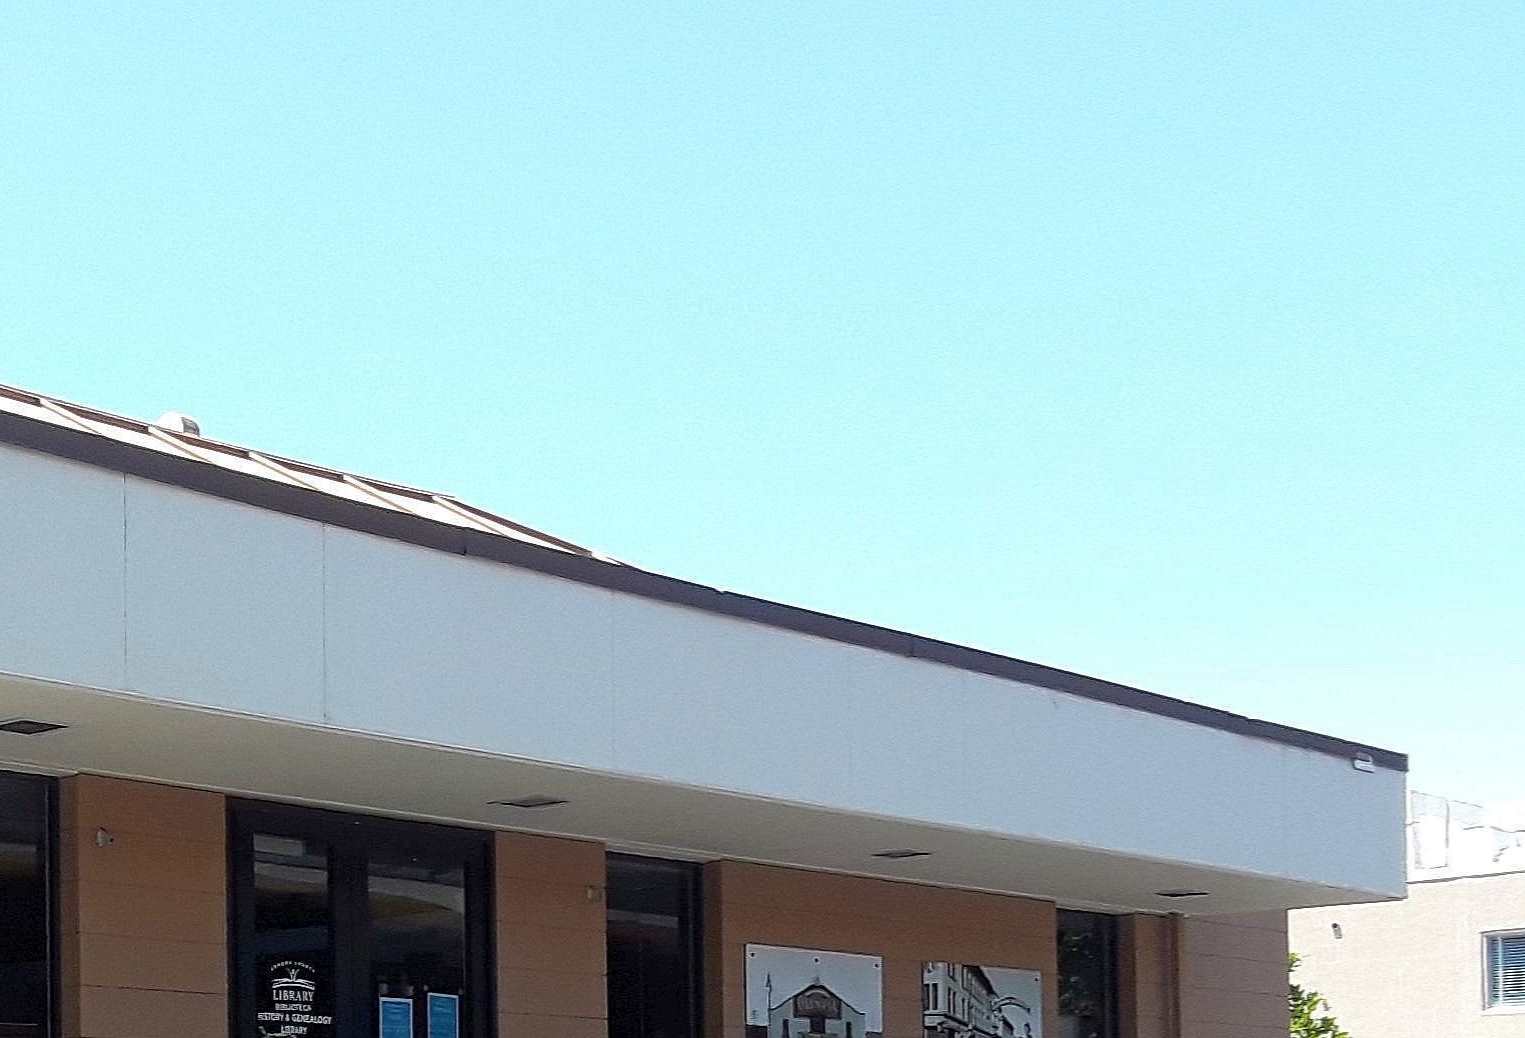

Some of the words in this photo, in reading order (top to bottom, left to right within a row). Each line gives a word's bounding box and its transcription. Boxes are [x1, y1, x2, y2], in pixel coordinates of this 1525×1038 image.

[272, 989, 315, 1002] LIBRARY
[285, 1014, 290, 1022] &
[291, 1013, 332, 1025] GENEALOGY
[280, 1025, 308, 1035] LIBRARY
